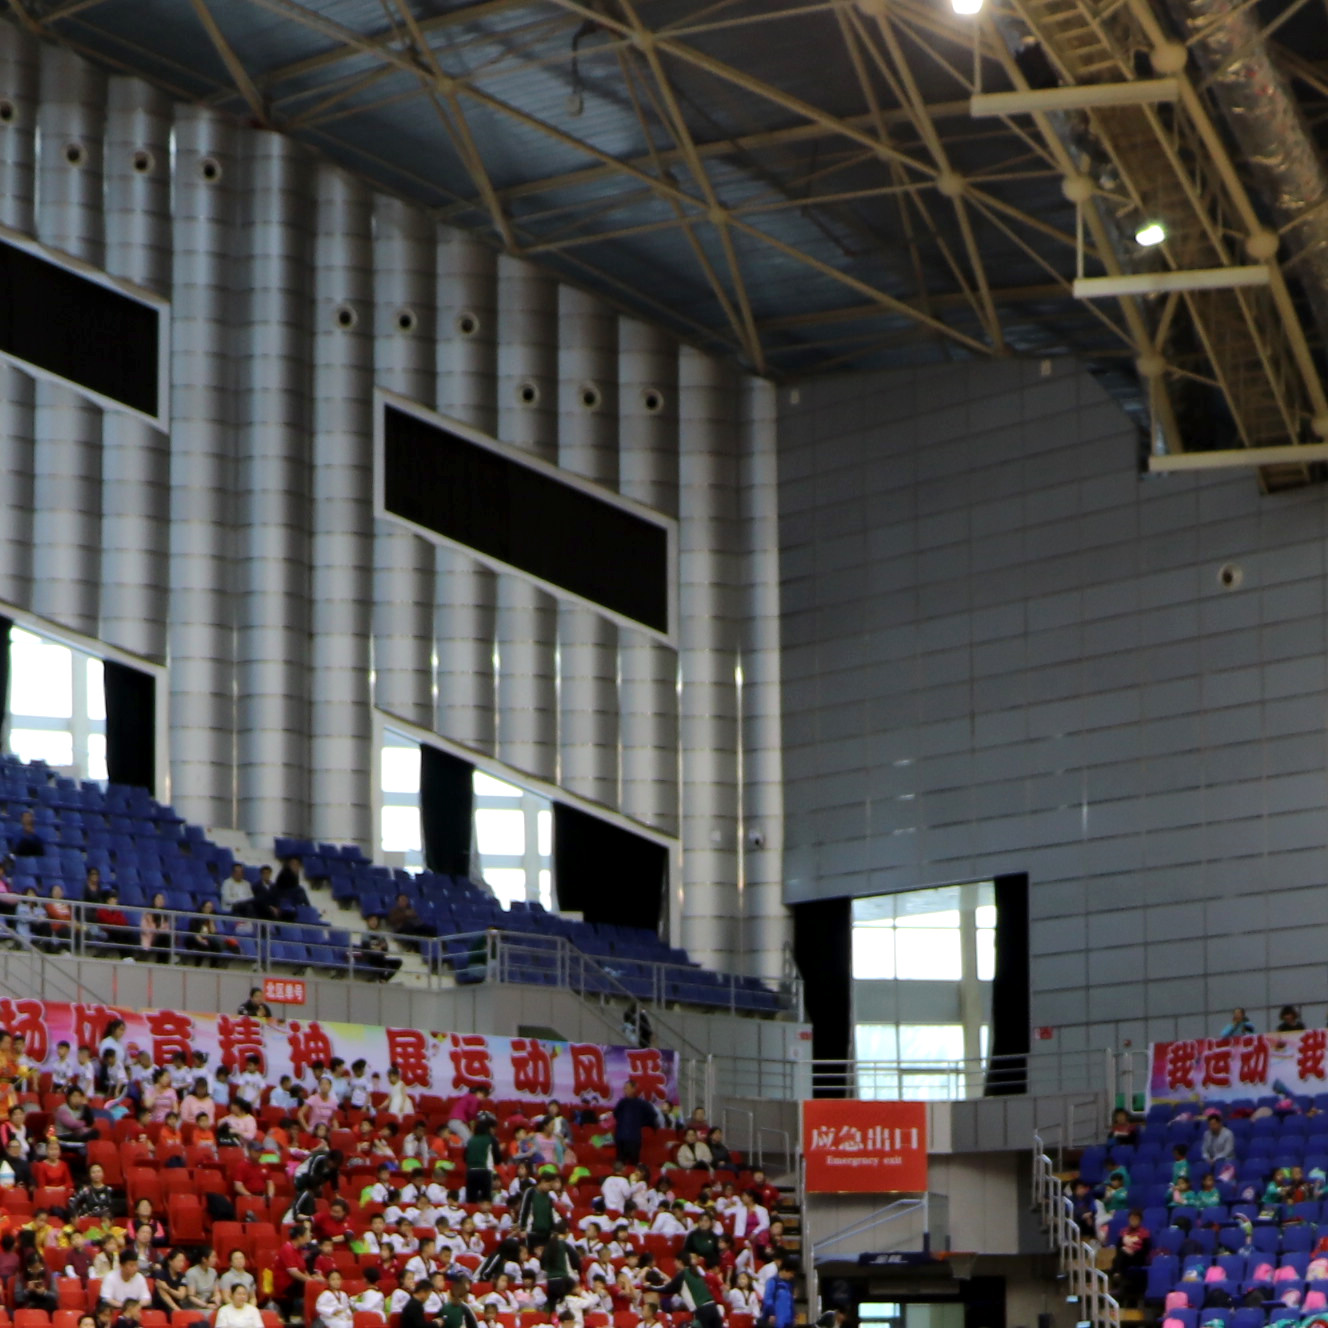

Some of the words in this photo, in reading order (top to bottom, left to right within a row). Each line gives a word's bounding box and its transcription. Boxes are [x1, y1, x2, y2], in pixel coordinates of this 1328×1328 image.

[266, 981, 304, 1002] 北区单号
[1165, 1037, 1272, 1092] 我运动
[811, 1125, 918, 1152] 应急出口
[883, 1155, 902, 1165] exit
